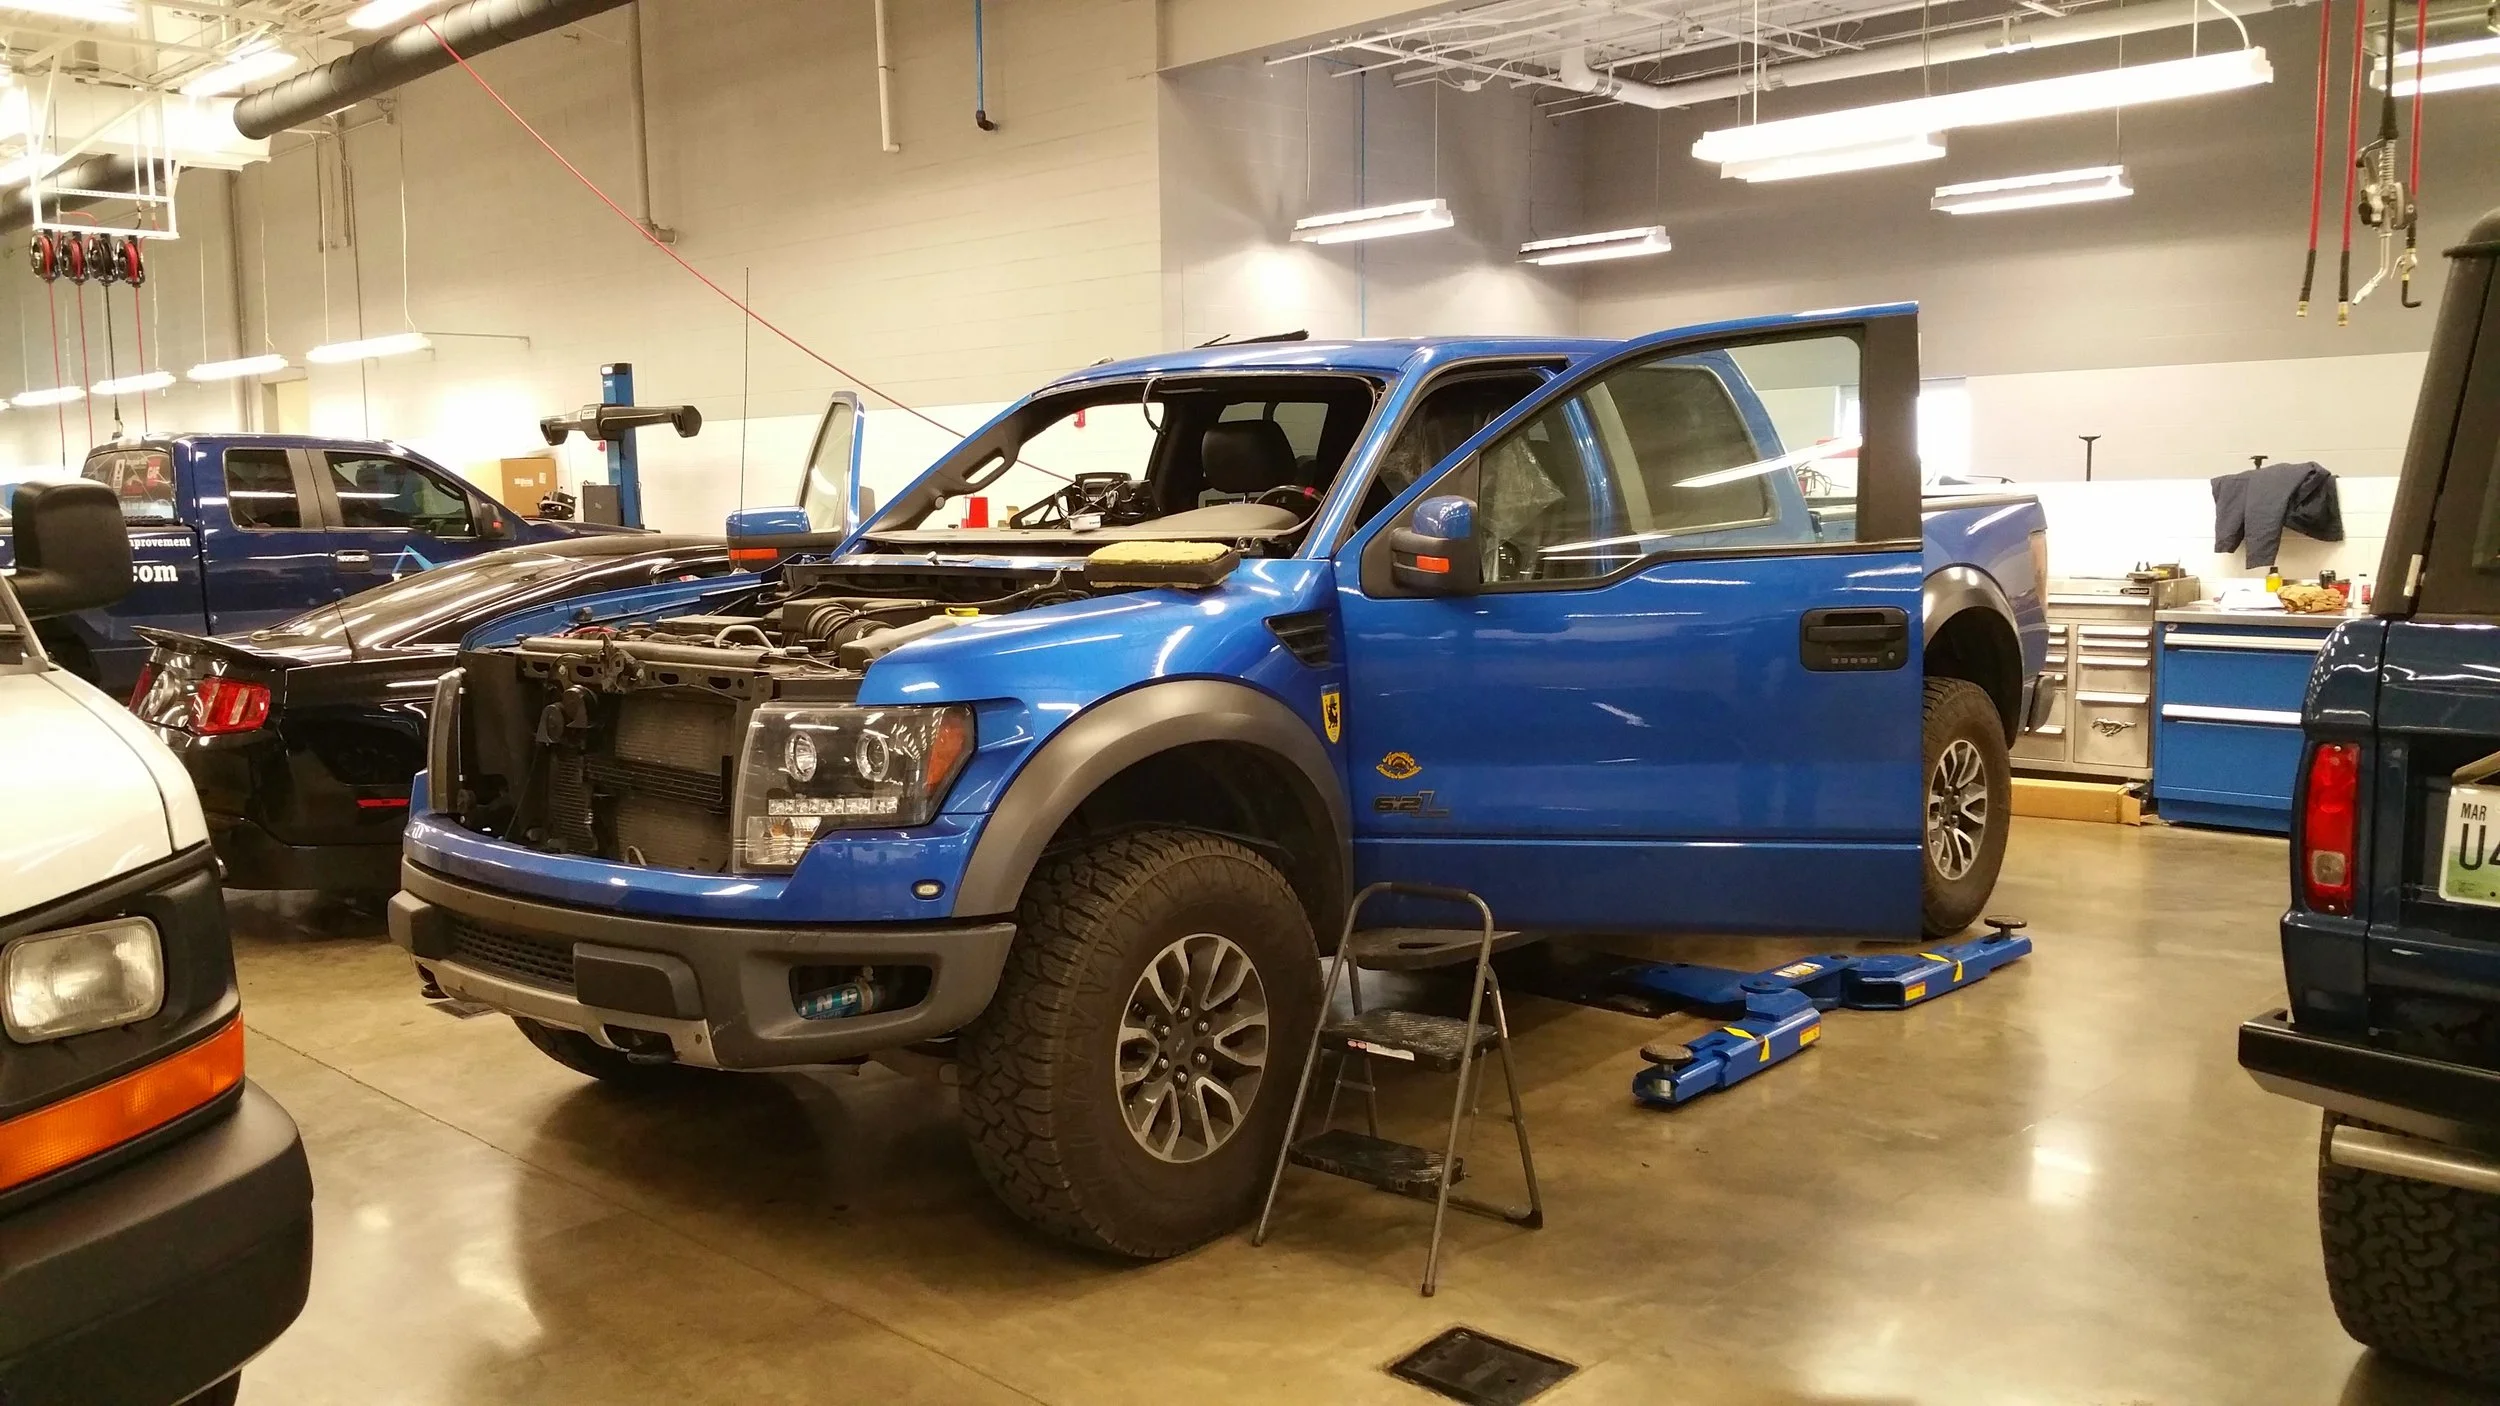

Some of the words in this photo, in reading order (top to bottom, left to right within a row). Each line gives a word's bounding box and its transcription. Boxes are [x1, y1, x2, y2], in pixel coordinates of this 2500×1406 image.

[129, 537, 191, 549] provement
[2460, 803, 2487, 822] MAR
[801, 987, 858, 1016] ING
